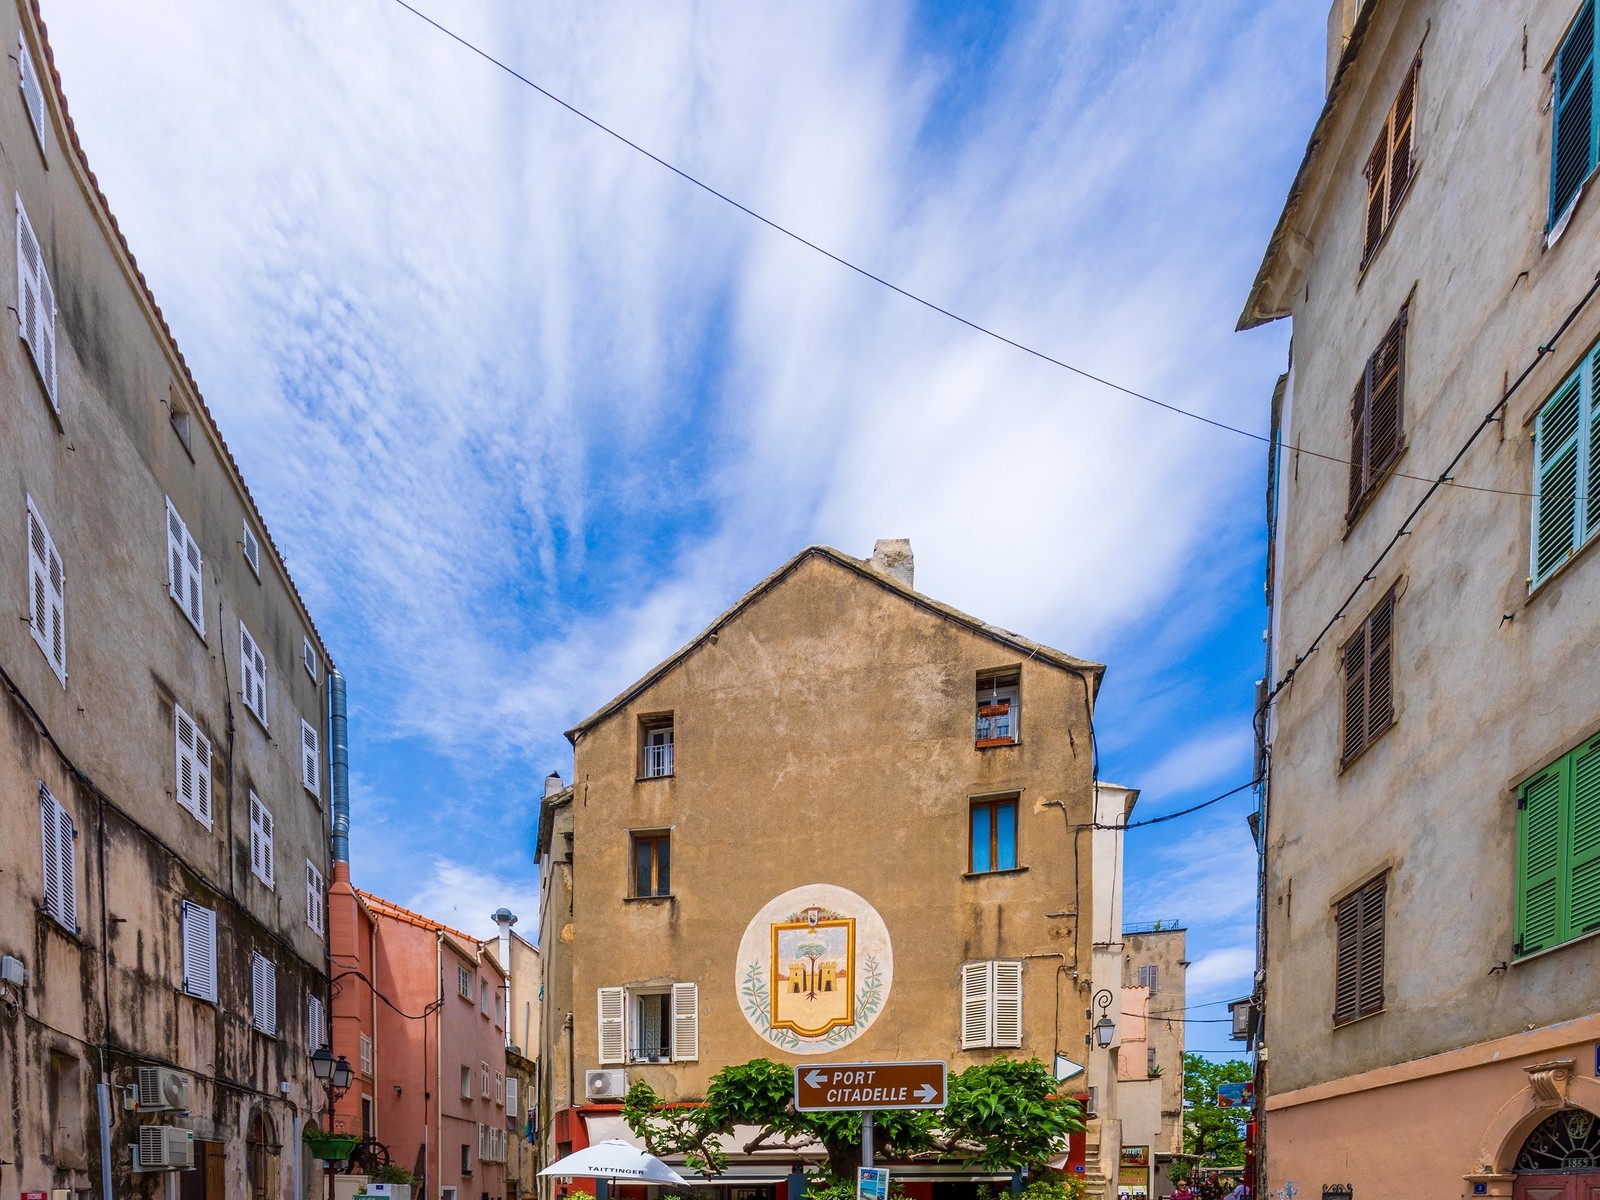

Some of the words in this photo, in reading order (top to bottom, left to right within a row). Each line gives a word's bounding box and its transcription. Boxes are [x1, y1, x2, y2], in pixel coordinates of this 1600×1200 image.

[833, 1071, 876, 1085] PORT
[826, 1087, 908, 1103] CITADELLE
[588, 1166, 644, 1175] TAITTINGER
